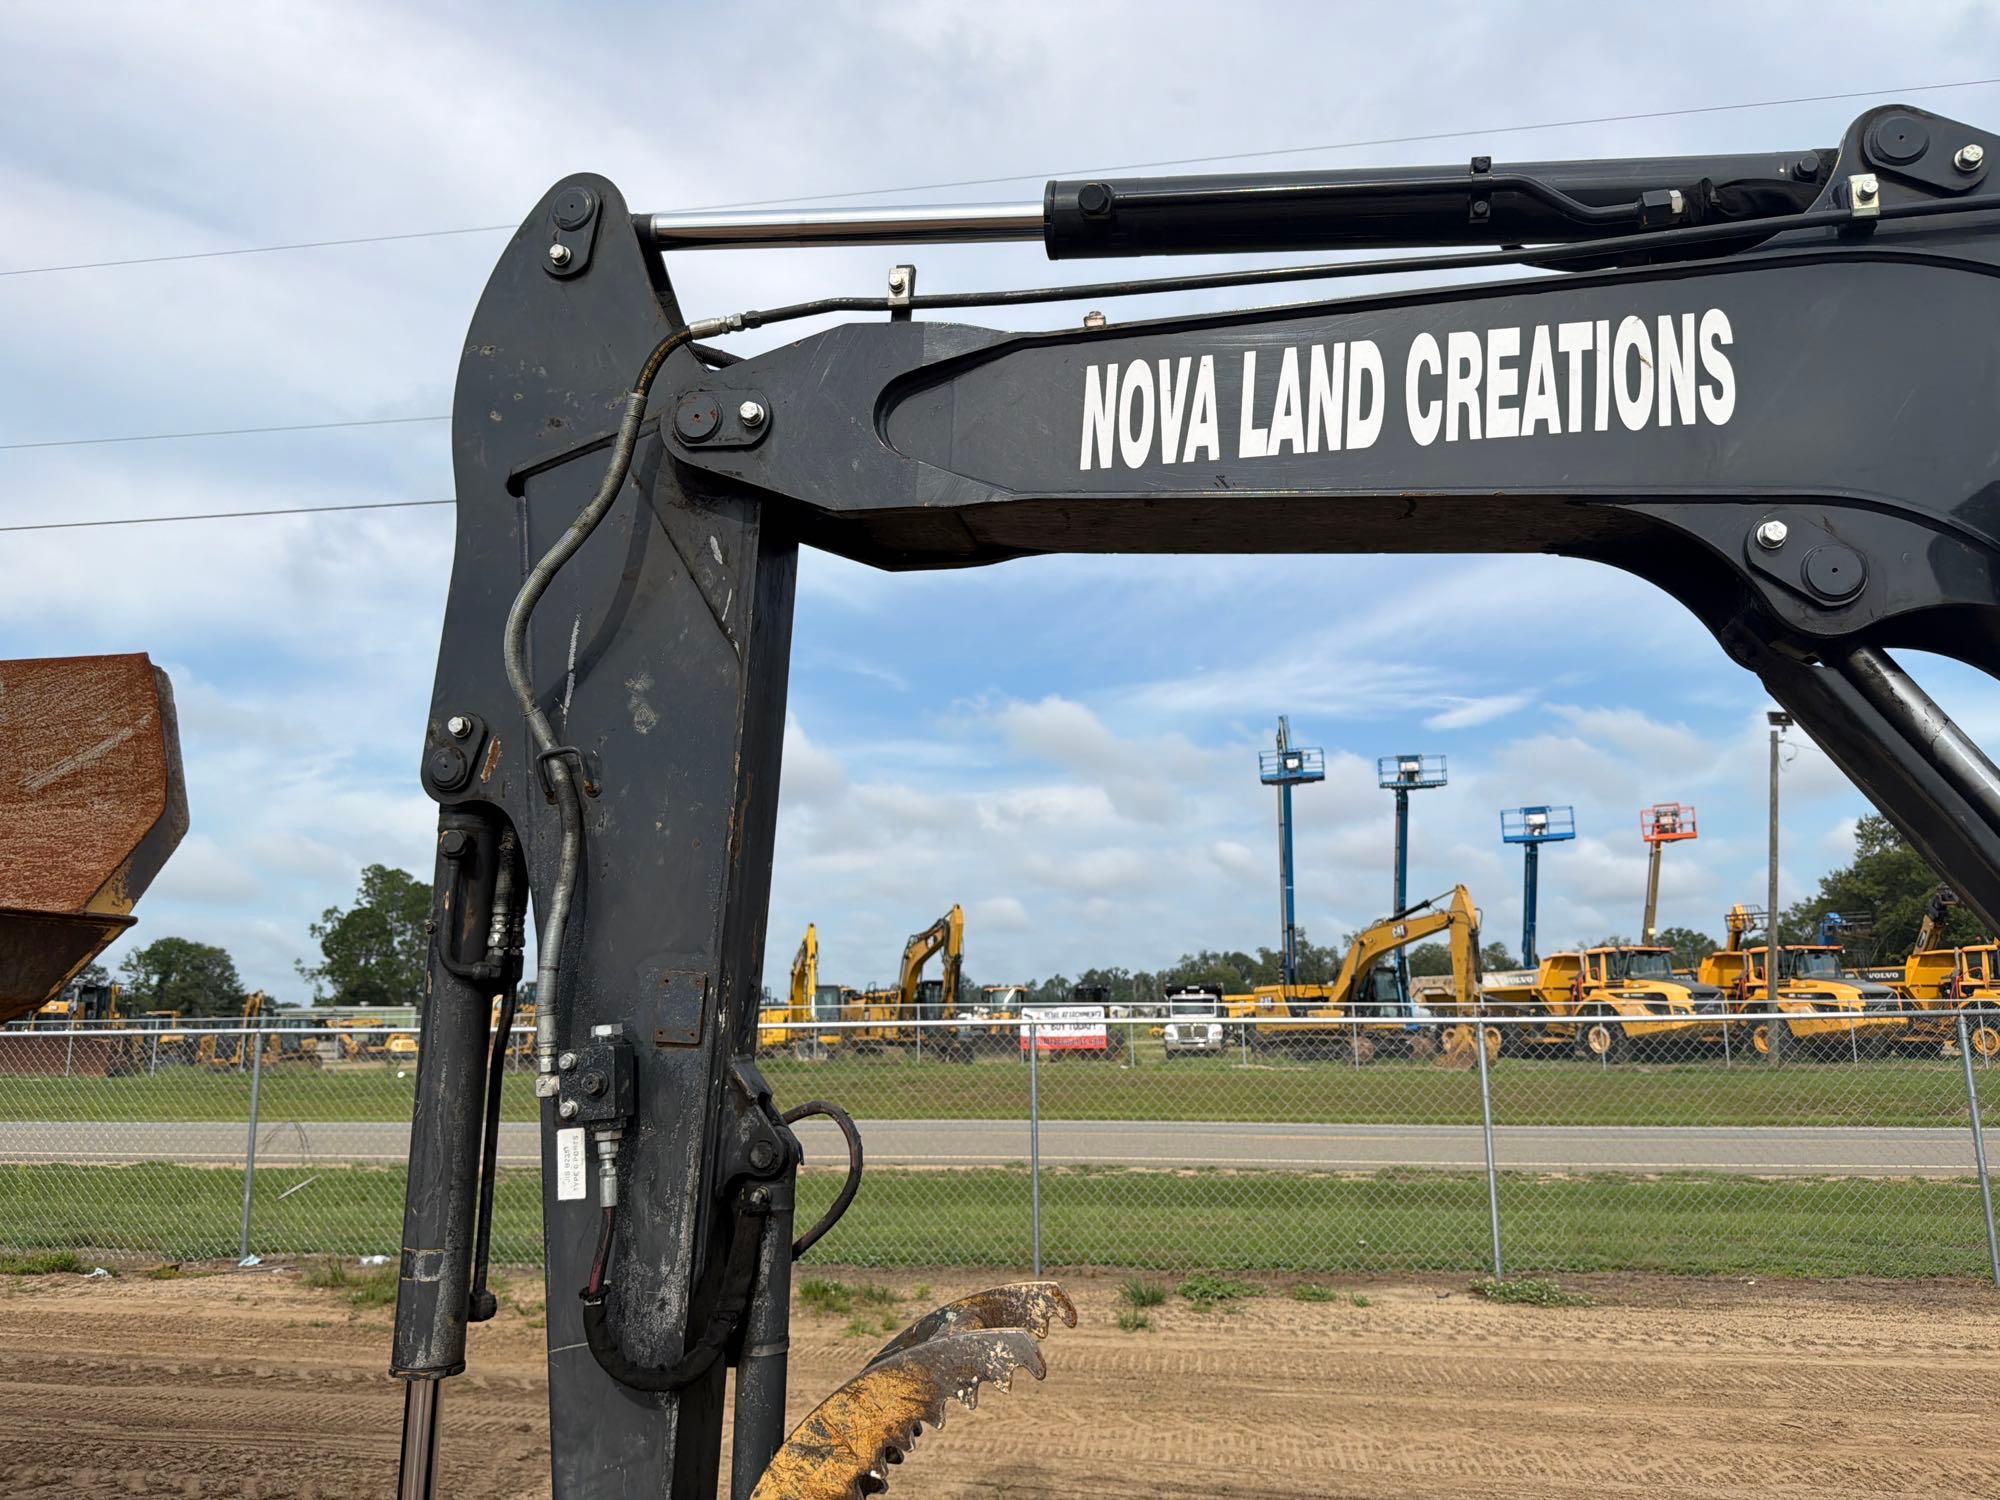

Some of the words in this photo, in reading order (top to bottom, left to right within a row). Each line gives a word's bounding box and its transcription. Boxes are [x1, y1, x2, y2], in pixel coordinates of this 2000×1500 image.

[1080, 353, 1220, 471] NOVA
[1238, 338, 1386, 460] LAND
[1404, 306, 1737, 448] CREATIONS
